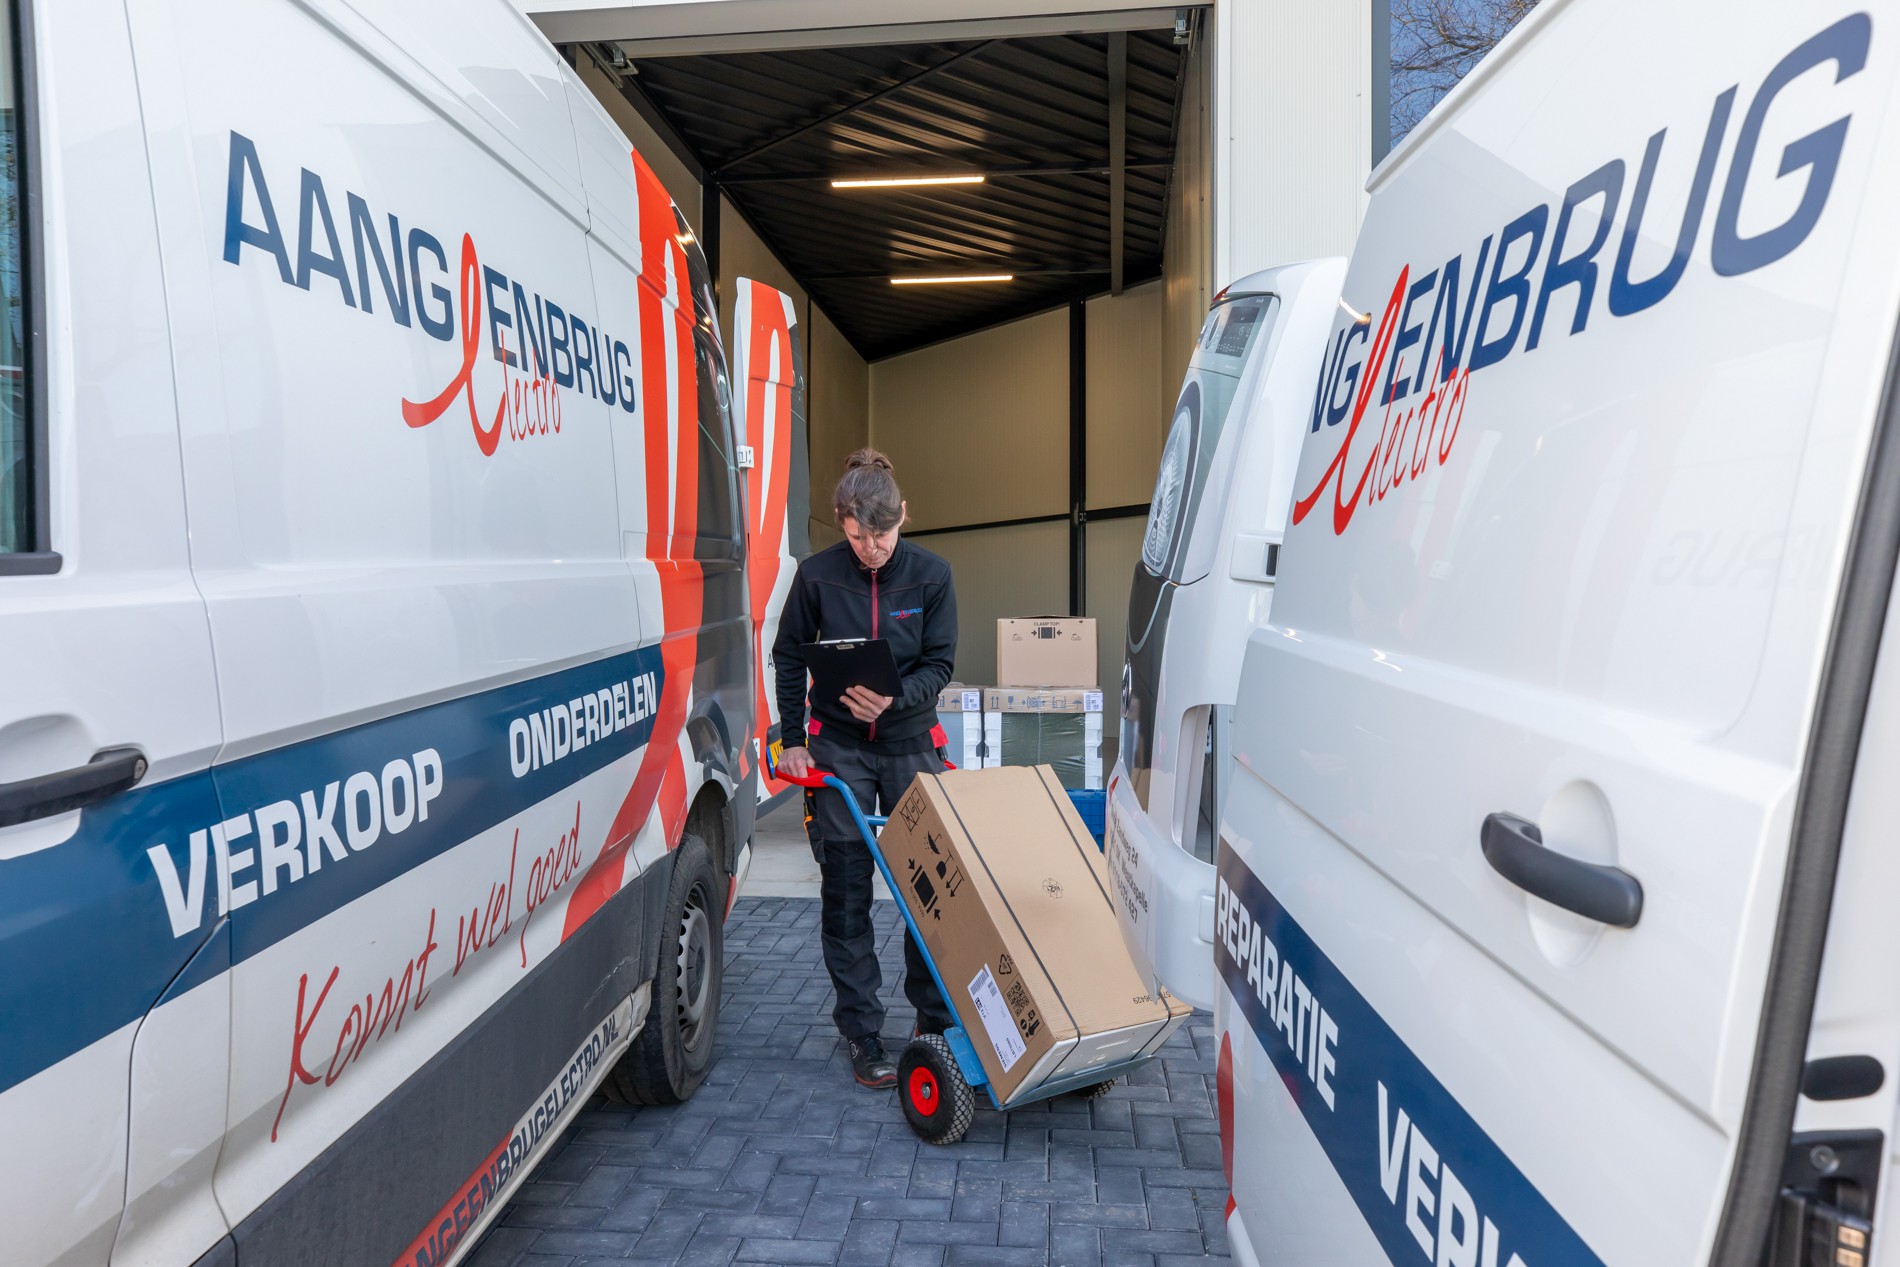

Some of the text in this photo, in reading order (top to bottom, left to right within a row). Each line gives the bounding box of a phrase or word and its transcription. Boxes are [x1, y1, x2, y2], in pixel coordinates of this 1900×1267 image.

[147, 672, 657, 938] VERKOOP ONDERDELEN
[520, 800, 582, 969] goed
[1217, 875, 1339, 1113] REPARATIE
[404, 1014, 619, 1267] NGEENBRUGELECTRO.NL
